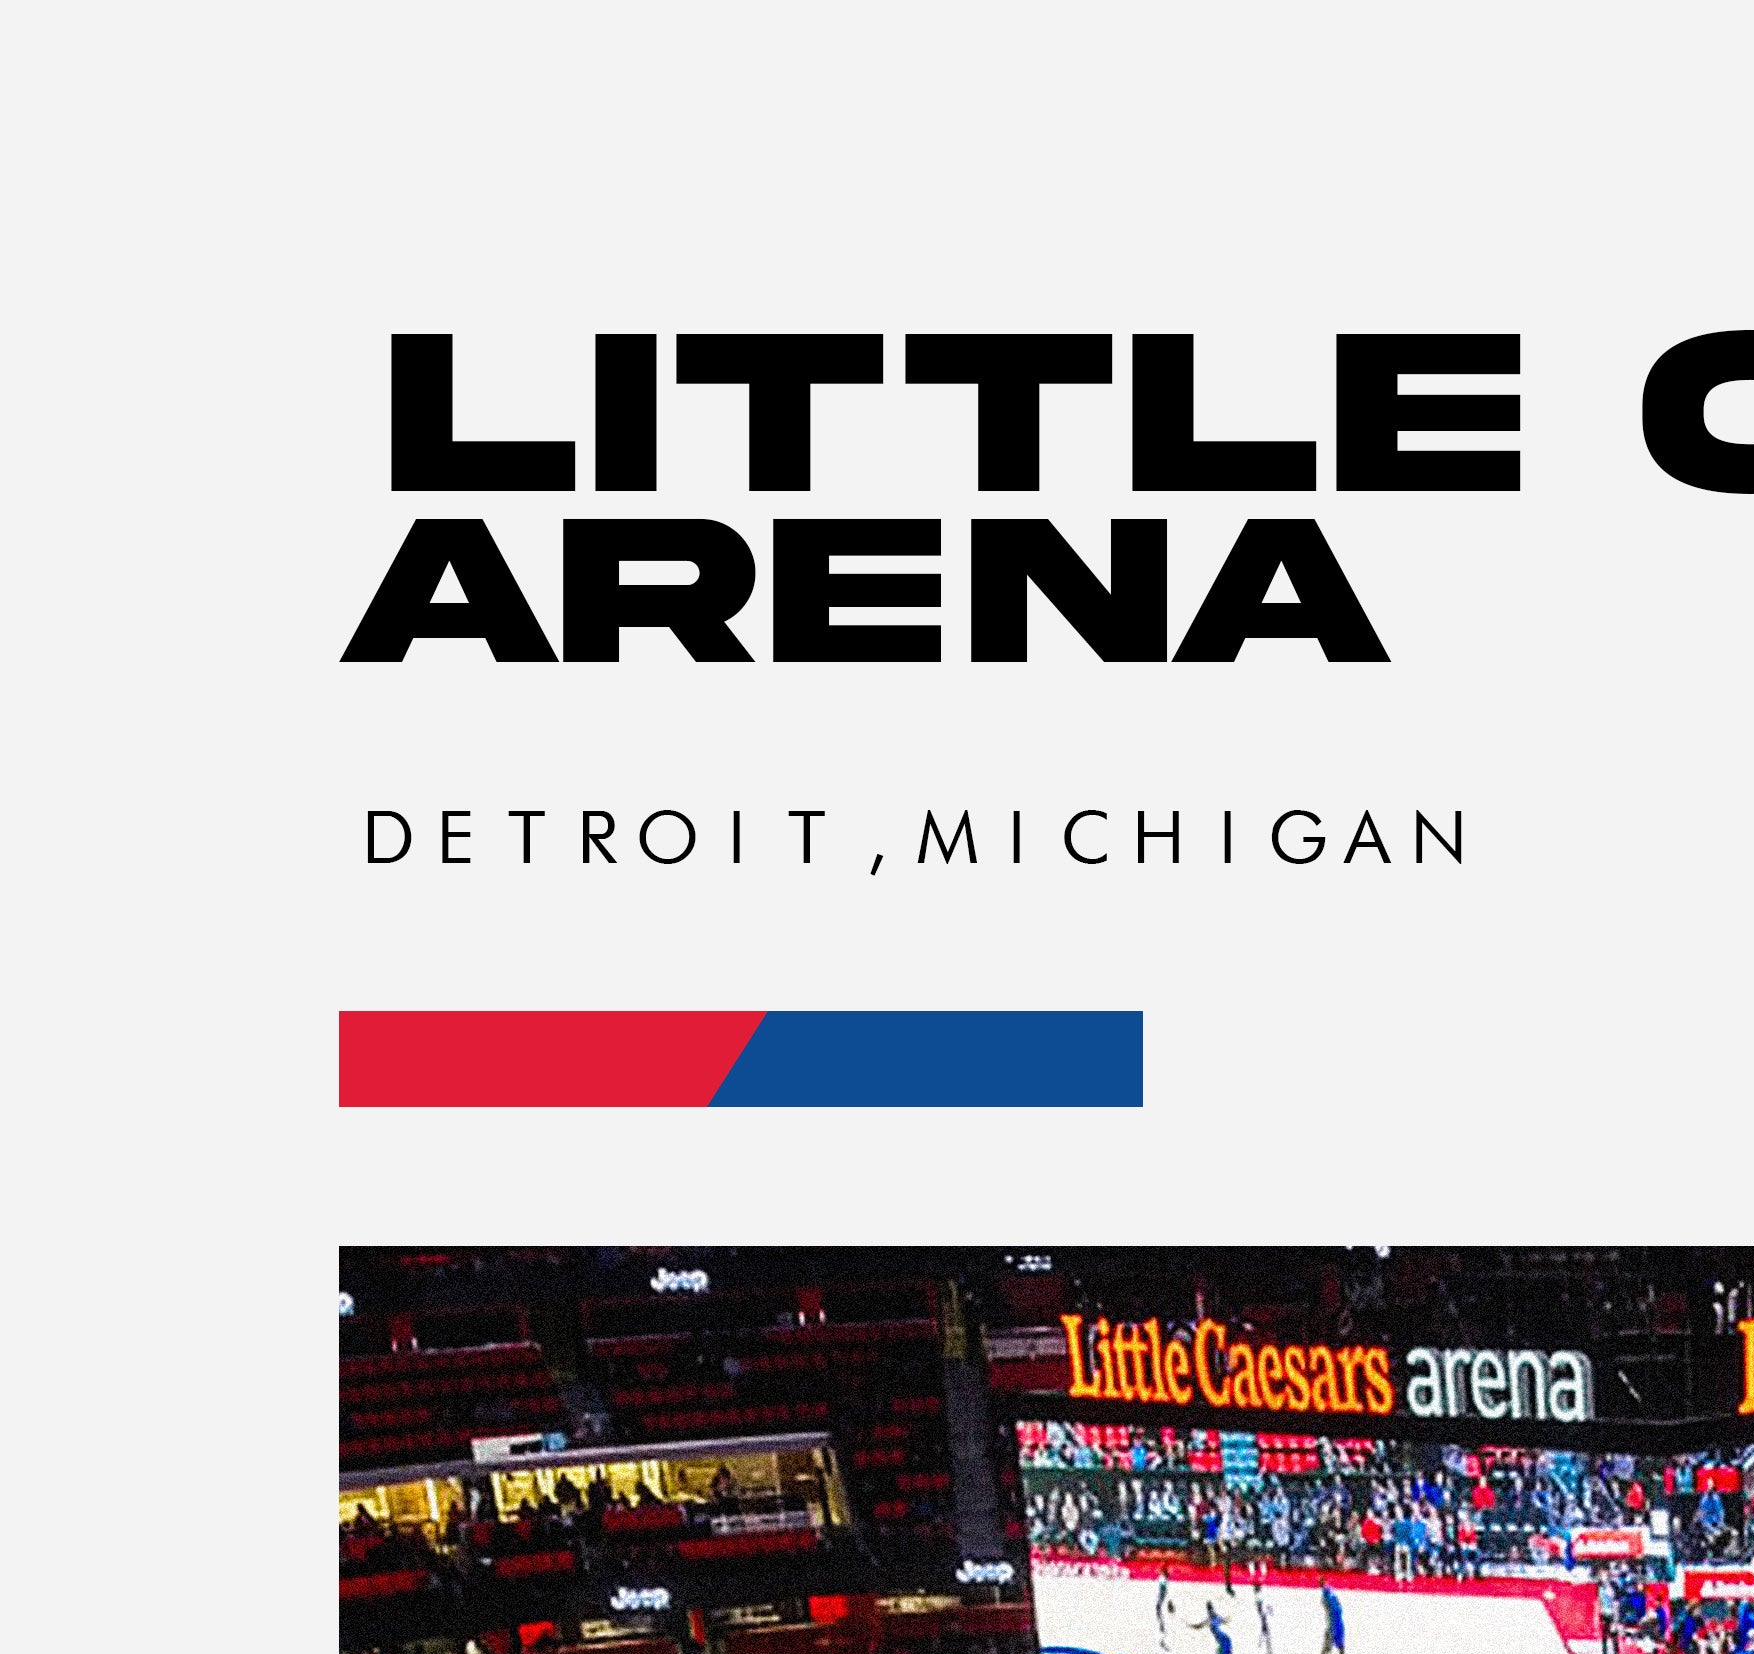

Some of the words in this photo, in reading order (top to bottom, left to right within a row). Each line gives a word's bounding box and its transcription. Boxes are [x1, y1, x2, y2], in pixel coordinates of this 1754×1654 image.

[391, 334, 1520, 491] LITTLE
[339, 519, 1391, 662] ARENA
[1061, 1314, 1195, 1404] Little
[1195, 1318, 1394, 1415] Caesars
[1406, 1347, 1594, 1422] arena
